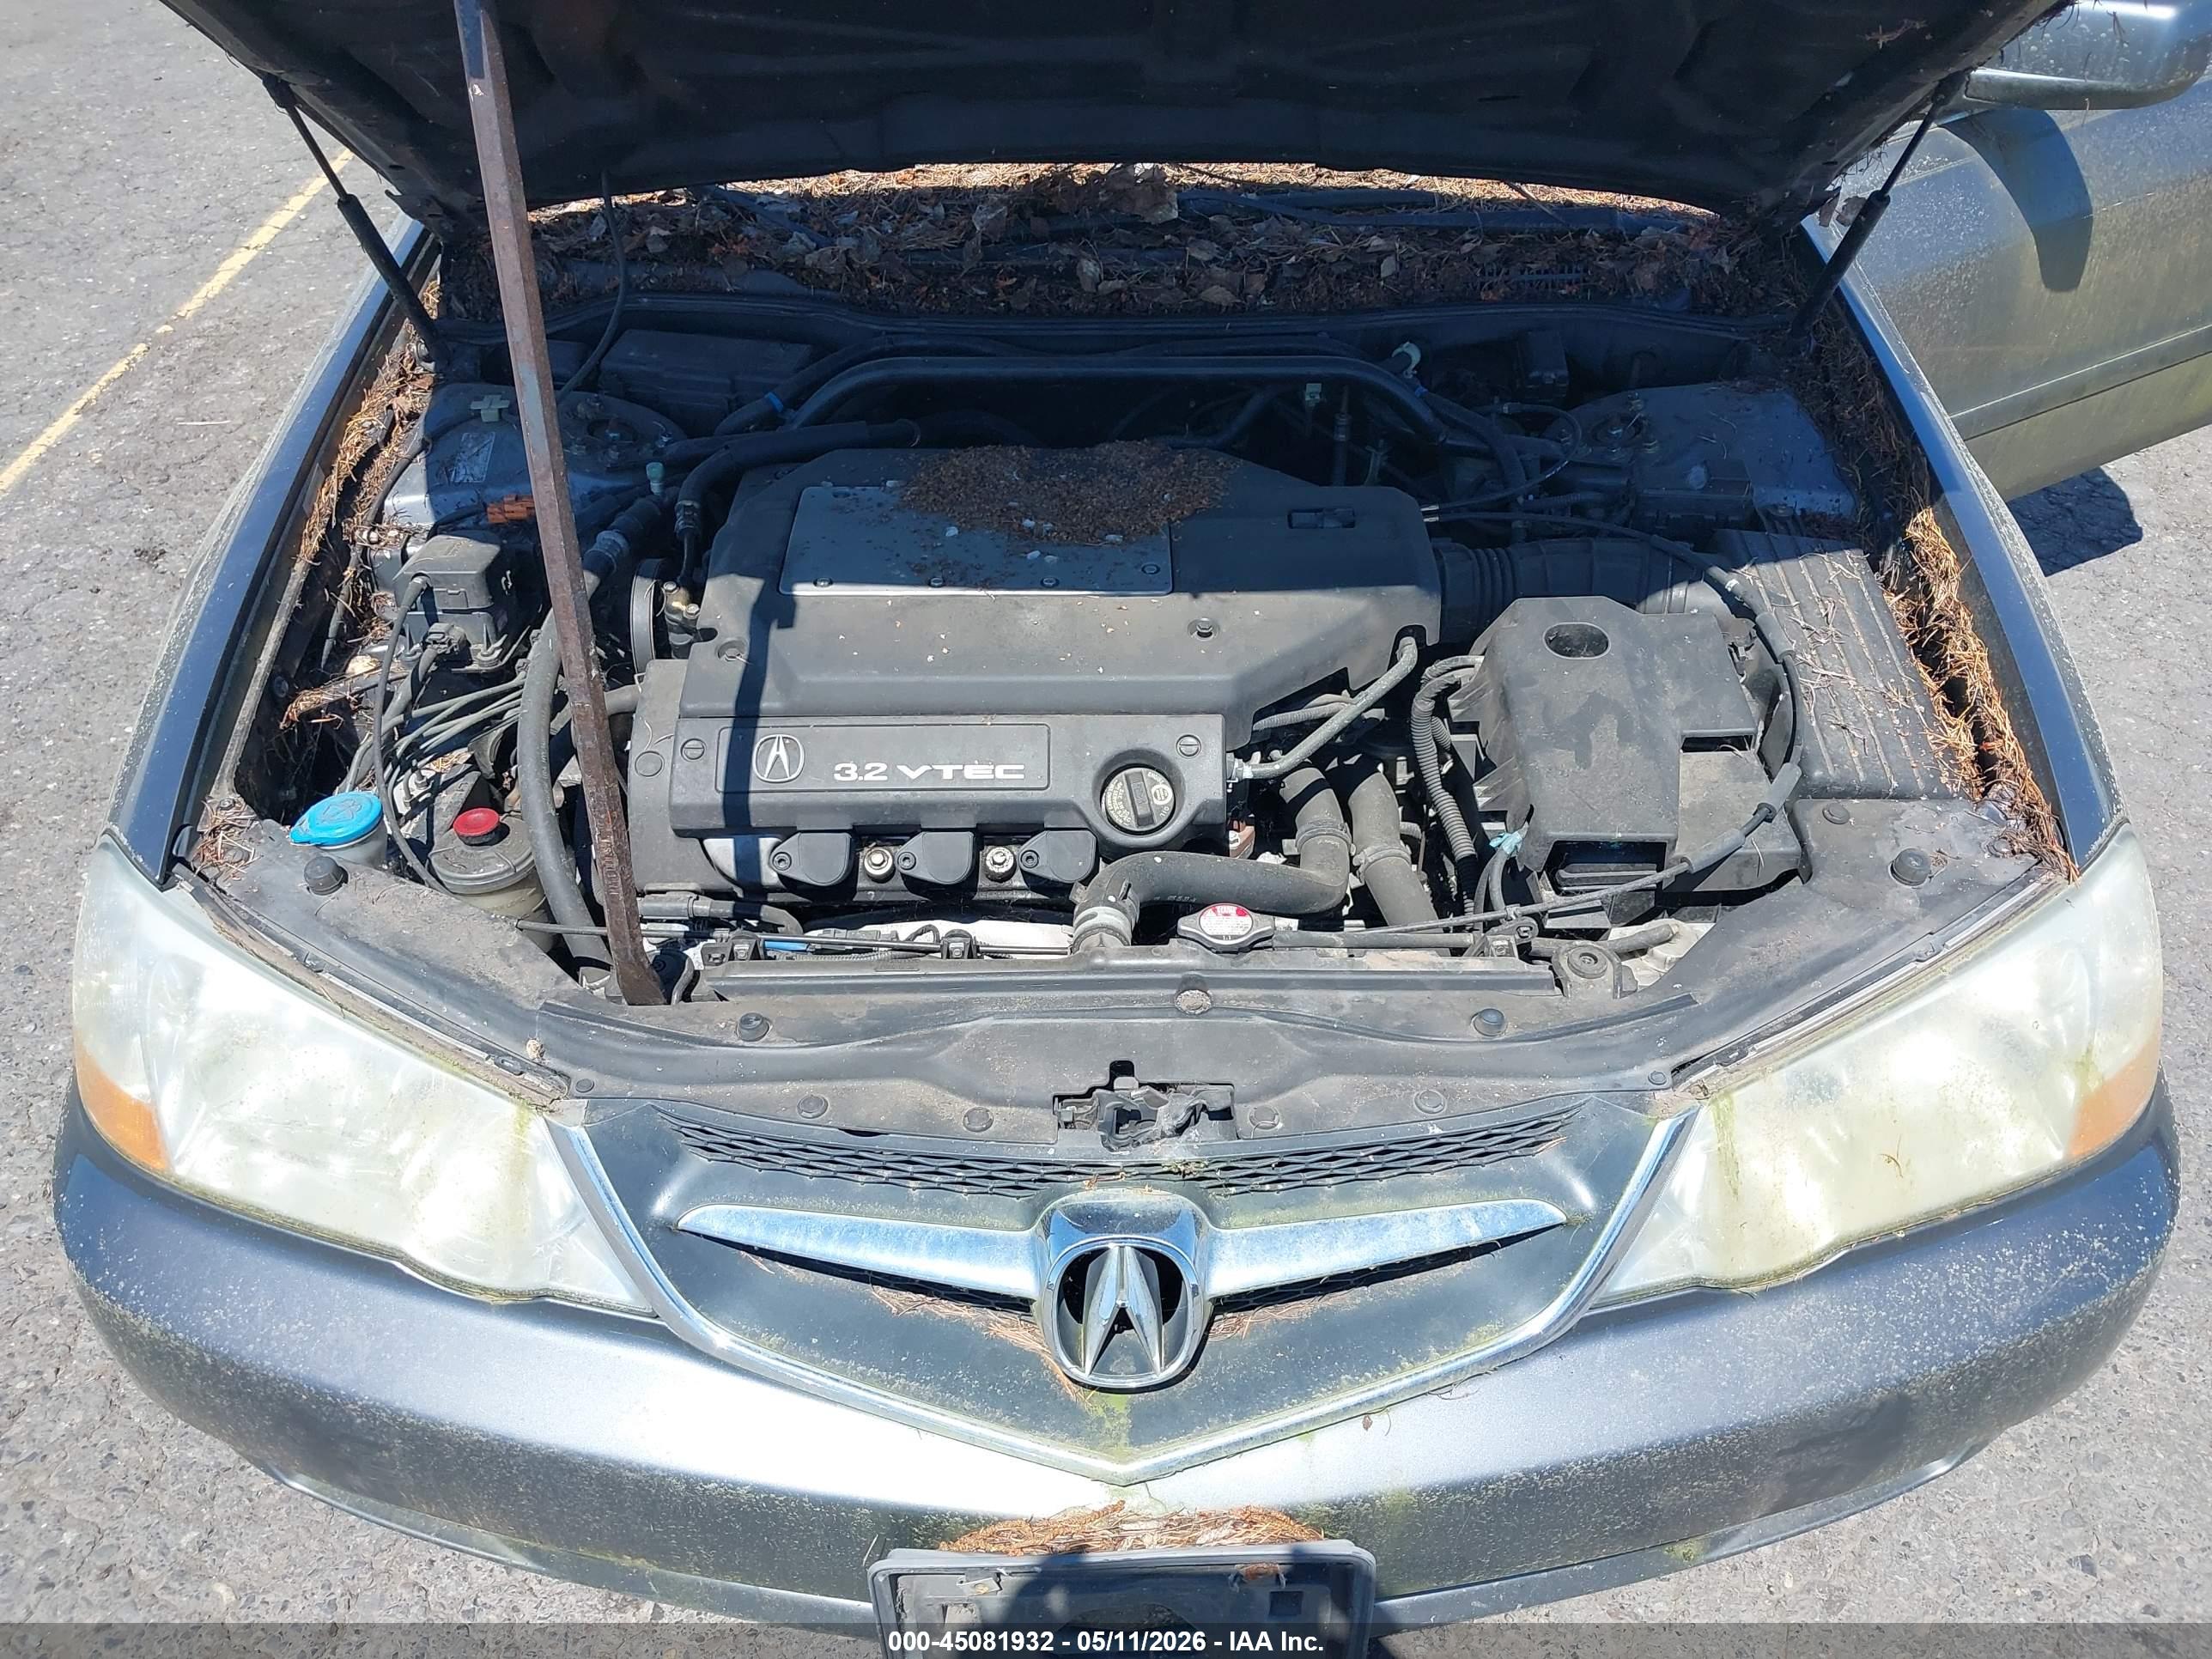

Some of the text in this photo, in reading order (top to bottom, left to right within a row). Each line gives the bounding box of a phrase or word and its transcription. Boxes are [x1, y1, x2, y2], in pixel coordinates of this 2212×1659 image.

[833, 762, 1025, 781] 3.2 VTEC
[1159, 805, 1170, 817] OIL
